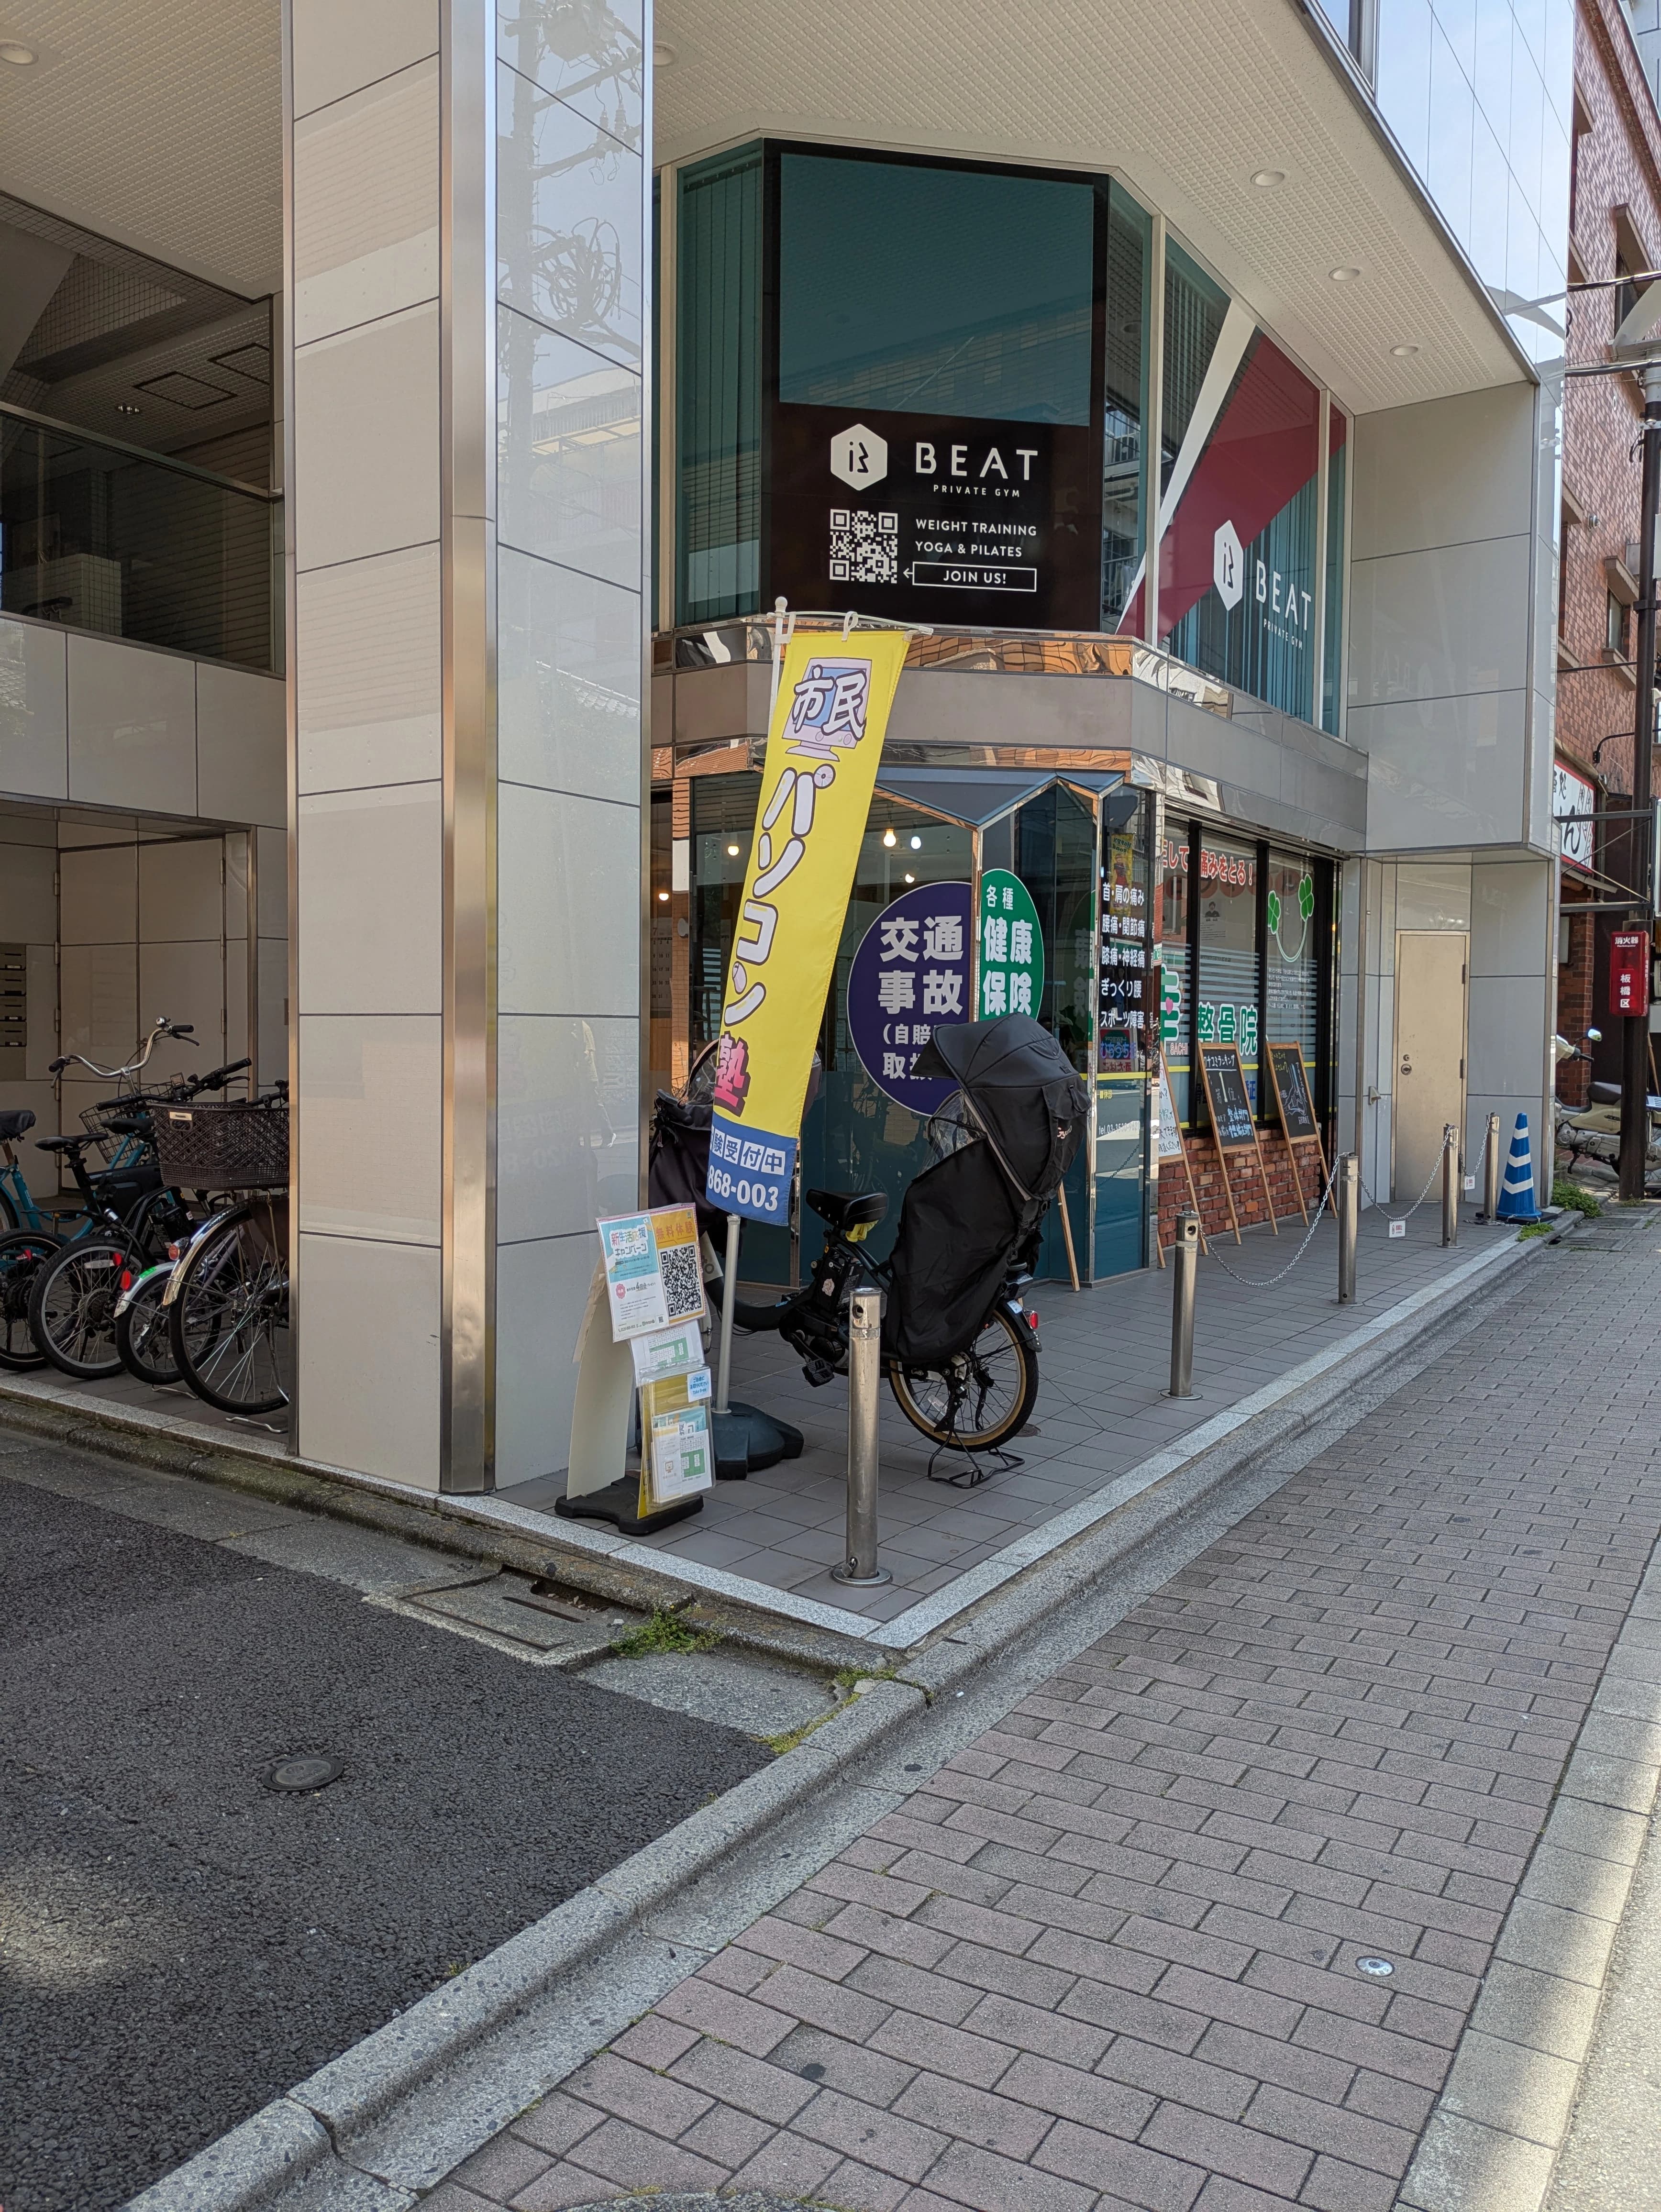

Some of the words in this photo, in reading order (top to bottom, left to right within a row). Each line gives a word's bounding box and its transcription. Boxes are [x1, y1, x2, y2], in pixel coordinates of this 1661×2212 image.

[916, 442, 1038, 481] BEAT
[933, 484, 987, 496] PRIVATE
[995, 488, 1020, 498] GYM
[915, 518, 967, 532] WEIGHT
[972, 522, 1037, 537] TRAINING
[915, 540, 953, 554] YOGA
[957, 543, 966, 554] &
[971, 544, 1022, 557] PILATES
[943, 570, 977, 583] JOIN
[984, 572, 1007, 585] US!
[1256, 559, 1311, 631] BEAT
[1263, 618, 1289, 642] PRIVATE
[1291, 635, 1303, 651] GYM
[793, 664, 867, 740] 市民
[986, 884, 1014, 911] 各種
[1102, 882, 1145, 907] 首・肩の痛み
[1102, 913, 1145, 938] 腰痛・関節痛
[879, 915, 963, 963] 交通
[983, 915, 1033, 965] 健康
[1615, 936, 1639, 944] 消火器
[1102, 947, 1145, 969] 膝痛・神経痛
[878, 969, 963, 1015] 事故
[983, 969, 1032, 1016] 保険
[1101, 978, 1142, 999] ぎっくり腰
[1620, 973, 1631, 1008] 板橋区
[1100, 1010, 1144, 1029] スポーツ障害
[1170, 1042, 1188, 1056] SACHI
[610, 1226, 647, 1247] 新生活応援
[656, 1220, 694, 1240] 無料体験
[614, 1243, 647, 1257] キャンペーン
